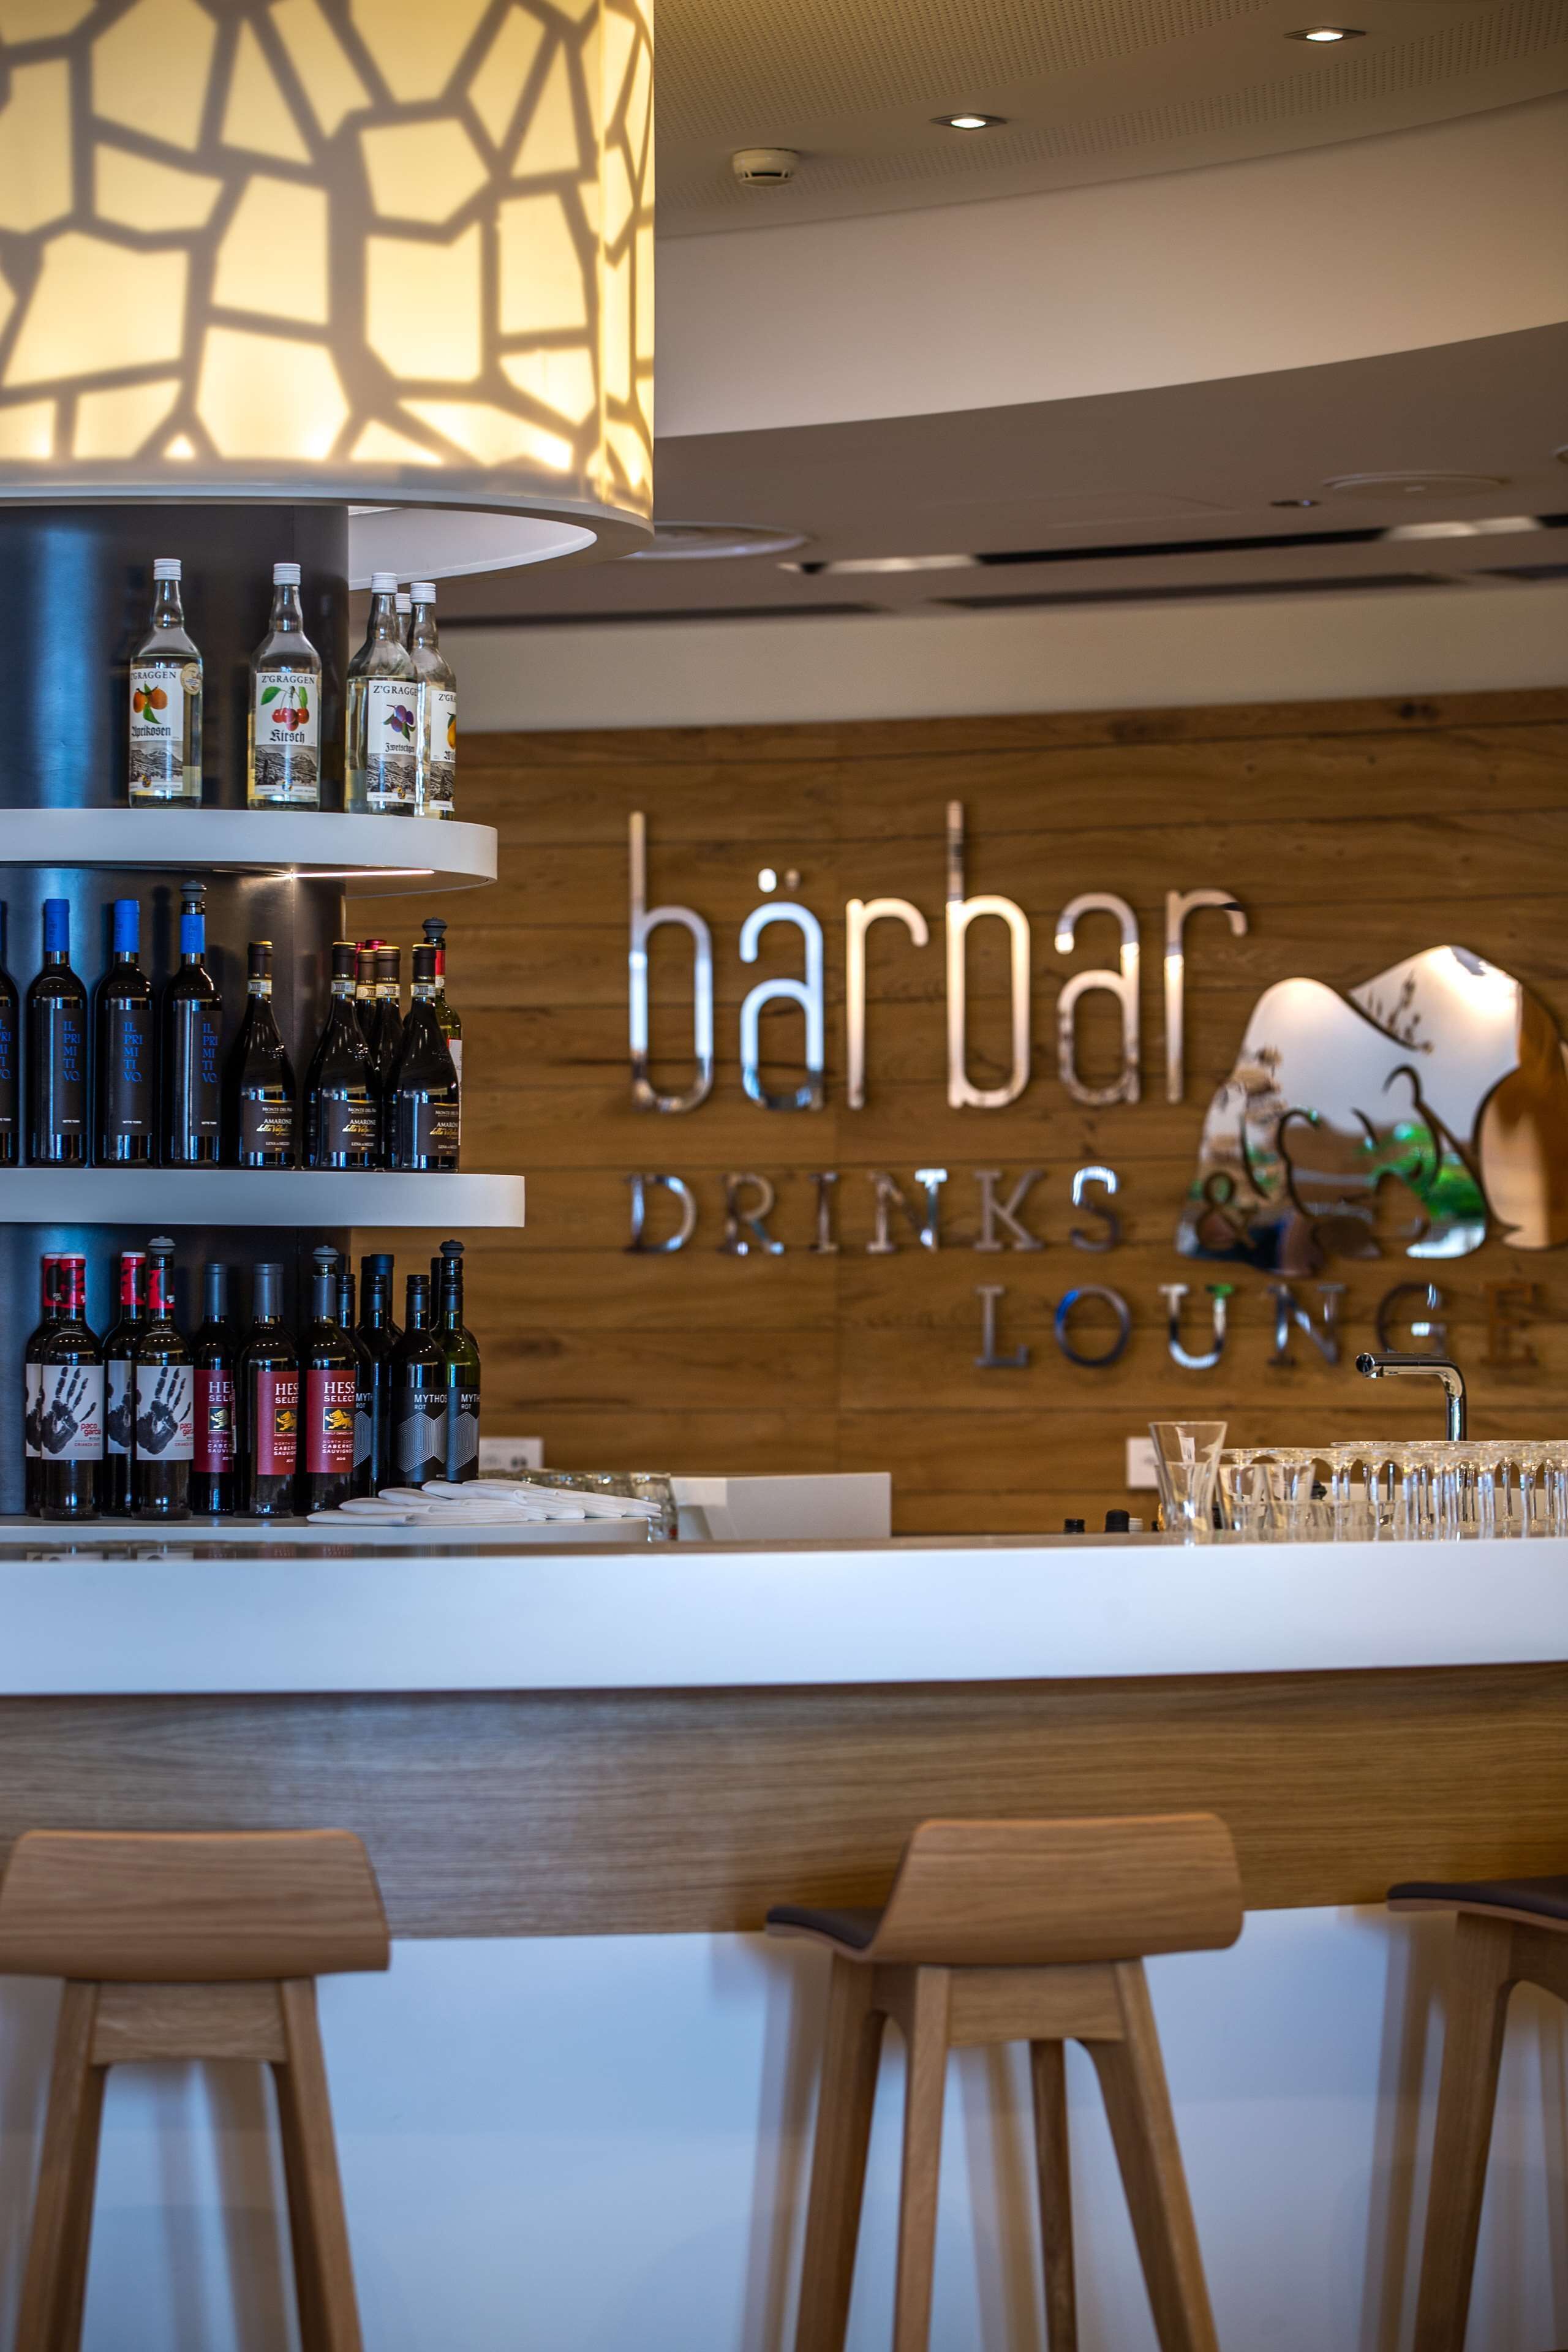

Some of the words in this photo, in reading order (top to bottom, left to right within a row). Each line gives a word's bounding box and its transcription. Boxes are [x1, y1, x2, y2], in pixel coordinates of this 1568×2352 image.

[262, 675, 315, 684] Z'GRAGGEN
[269, 729, 306, 744] Kirsch
[628, 799, 1248, 1112] bärbar
[63, 1020, 75, 1031] IL
[124, 1022, 137, 1032] IL
[203, 1023, 214, 1033] IL
[63, 1033, 81, 1044] PRI
[124, 1035, 143, 1045] PRI
[202, 1035, 219, 1046] PRI
[63, 1046, 77, 1057] MI
[124, 1047, 140, 1057] MI
[202, 1048, 216, 1058] MI
[63, 1058, 75, 1069] TI
[124, 1059, 137, 1069] TI
[202, 1060, 213, 1071] TI
[625, 1166, 1122, 1254] DRINKS
[974, 1281, 1544, 1371] LOUNGE
[208, 1381, 234, 1394] HE
[323, 1381, 355, 1394] HESS
